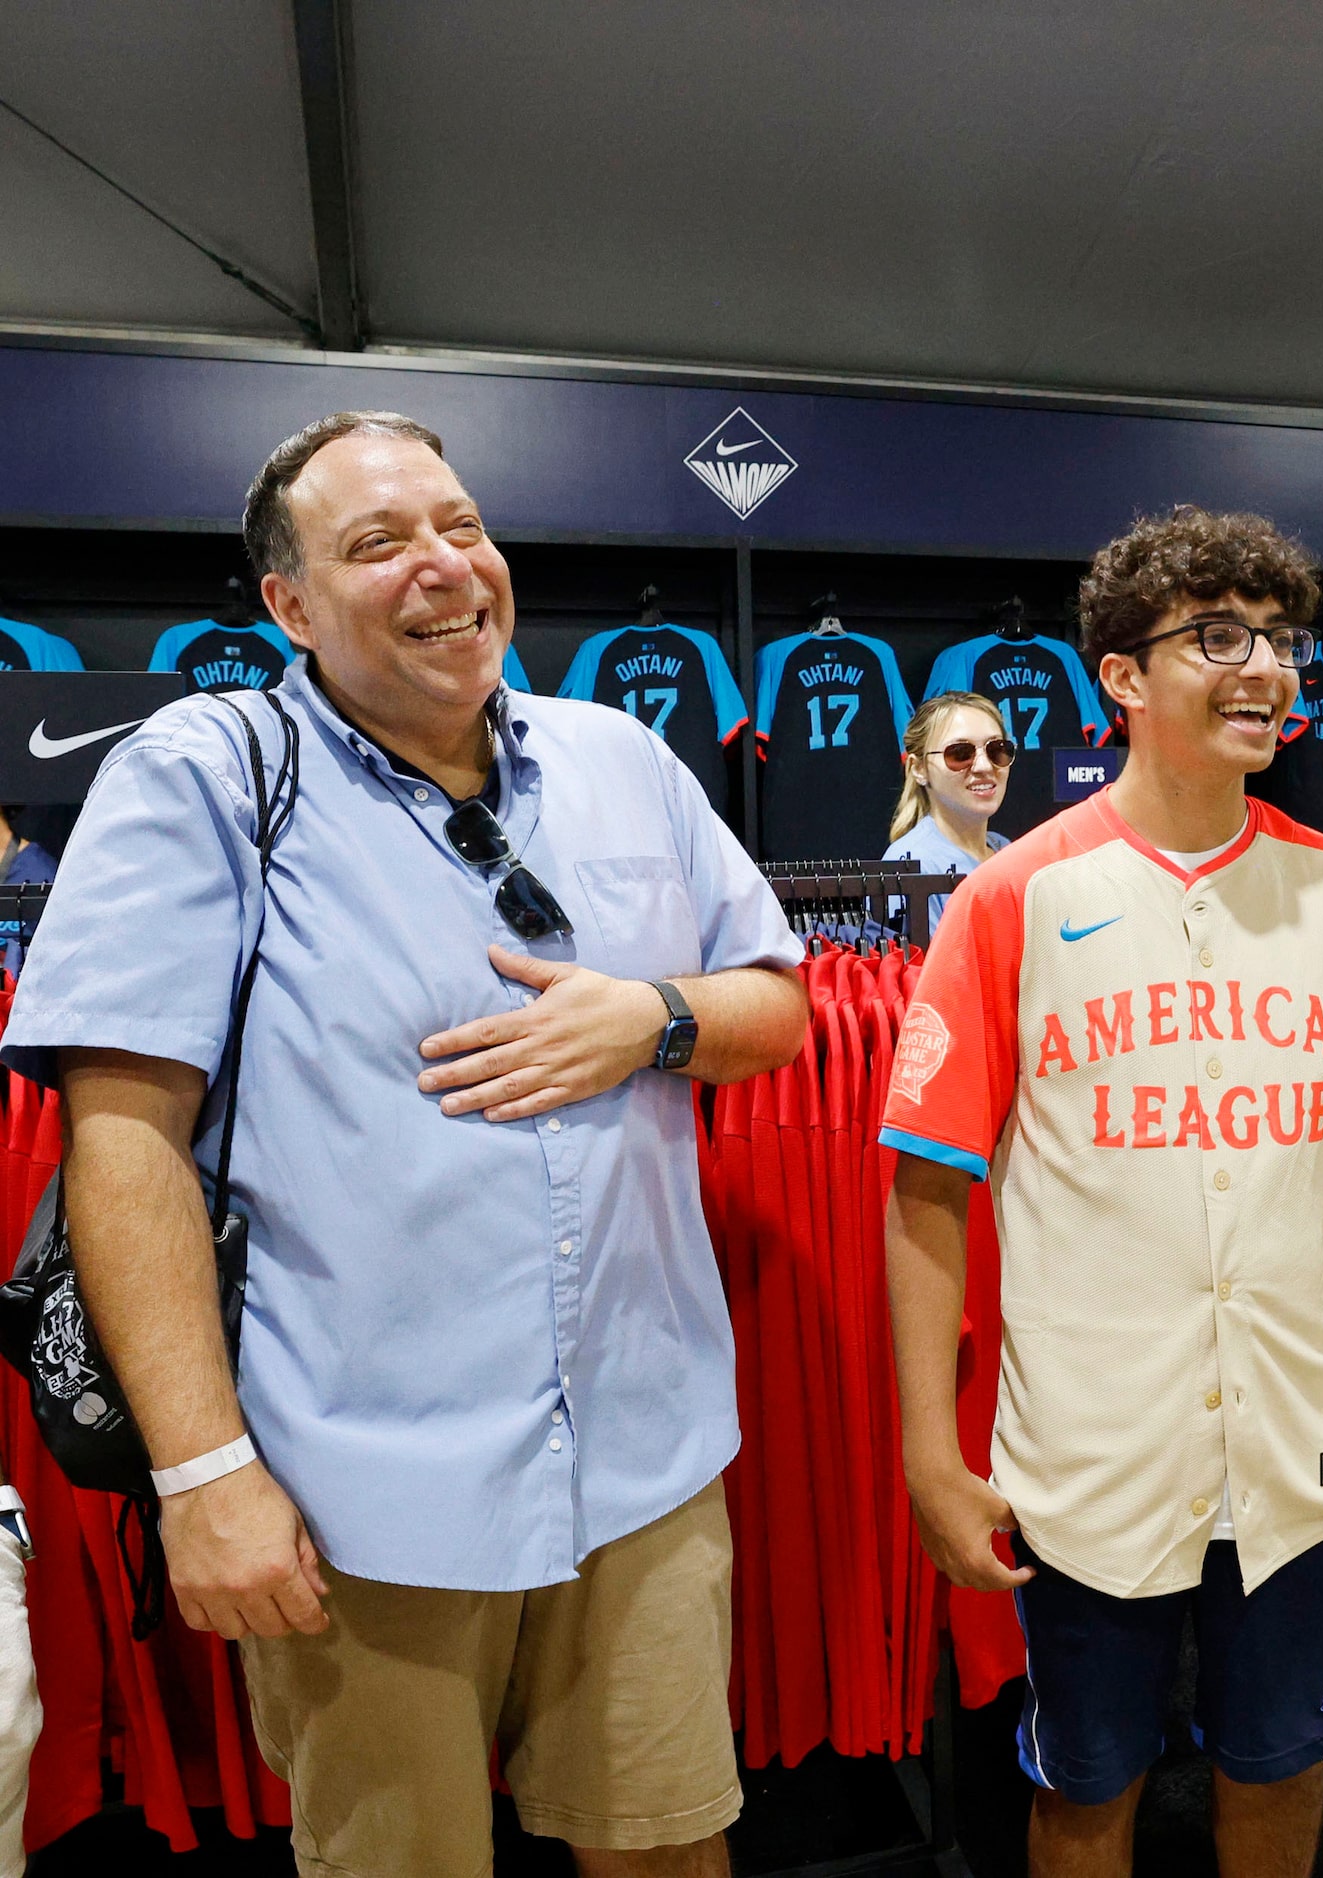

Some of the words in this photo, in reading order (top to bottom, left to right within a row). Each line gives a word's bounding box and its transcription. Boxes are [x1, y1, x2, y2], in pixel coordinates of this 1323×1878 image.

[690, 460, 789, 514] DIAMOND
[192, 660, 269, 691] OHTANI
[615, 654, 683, 682] OHTANI
[798, 663, 864, 688] OHTANI
[990, 667, 1052, 690] OHTANI
[807, 694, 860, 750] 17
[998, 697, 1048, 750] 17
[1067, 766, 1105, 783] MEN'S
